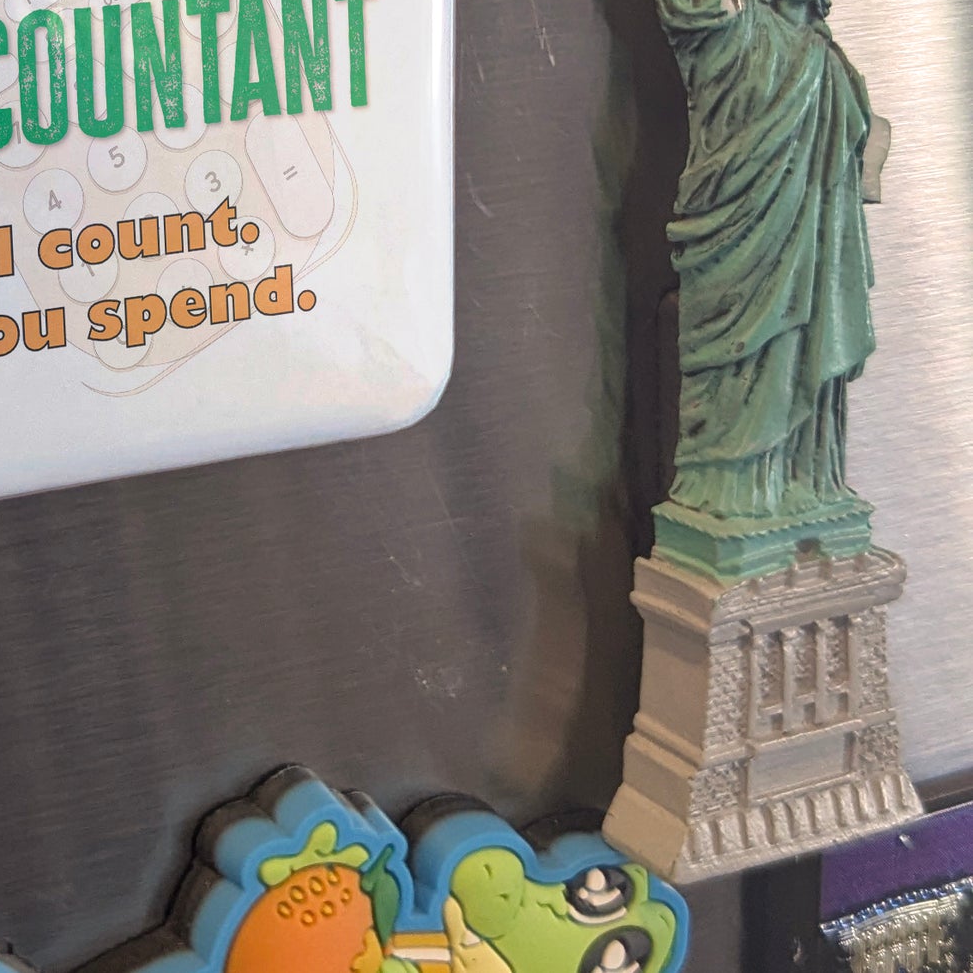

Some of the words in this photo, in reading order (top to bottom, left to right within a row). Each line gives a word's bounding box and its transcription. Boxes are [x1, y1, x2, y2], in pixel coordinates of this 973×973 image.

[108, 145, 126, 168] 5
[204, 170, 222, 193] 3
[48, 189, 63, 211] 4
[38, 195, 260, 270] count.
[87, 264, 317, 348] spend.
